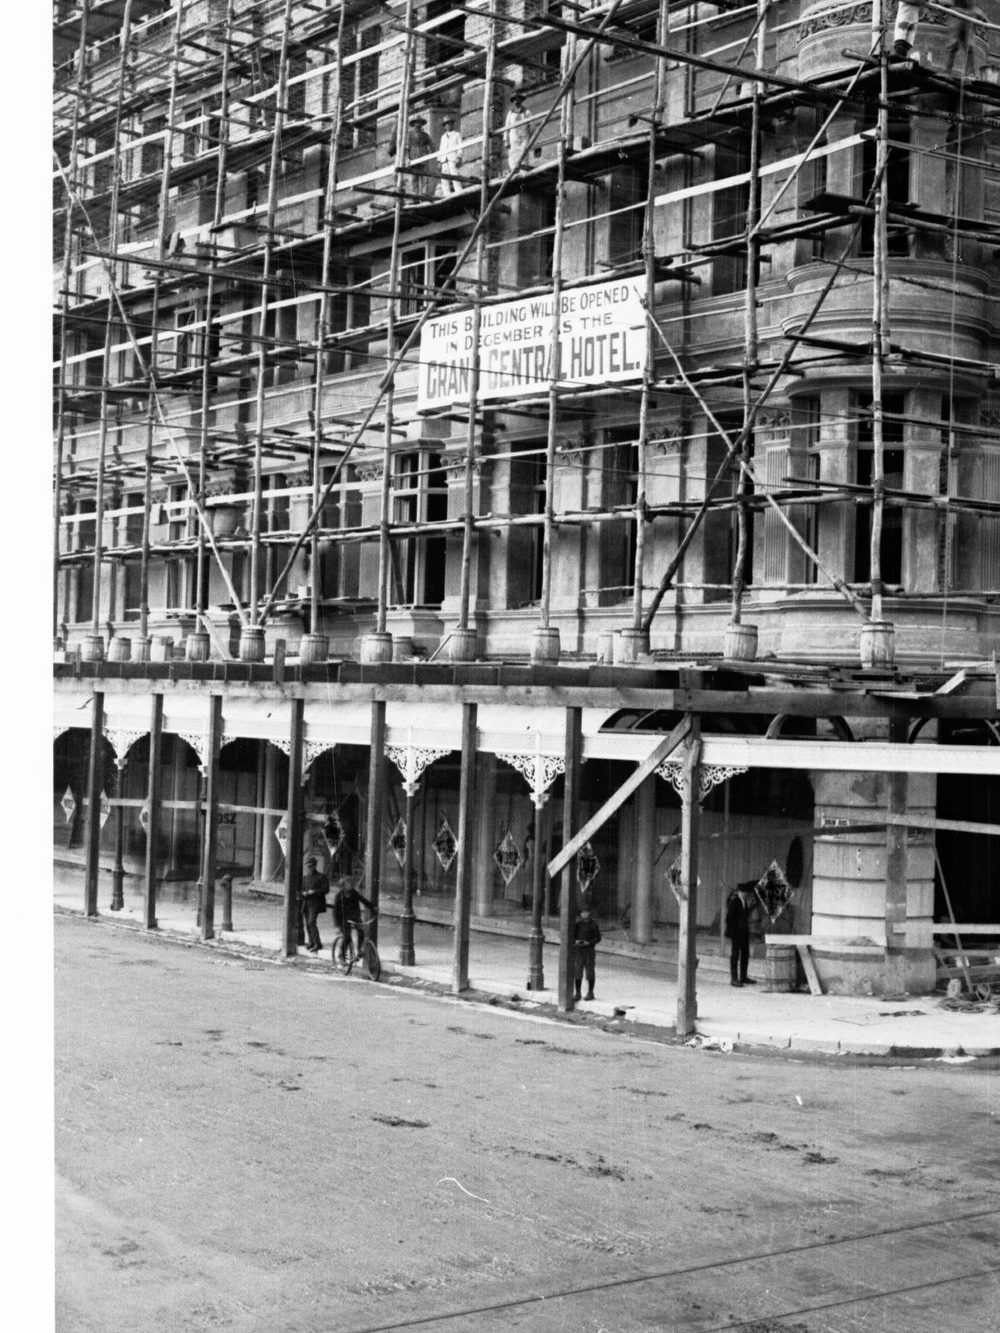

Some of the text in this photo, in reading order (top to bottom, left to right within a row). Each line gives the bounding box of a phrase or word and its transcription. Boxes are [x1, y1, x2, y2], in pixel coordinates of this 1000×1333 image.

[430, 320, 458, 339] THIS
[464, 307, 526, 332] BILDING
[561, 296, 576, 314] BE
[580, 285, 629, 310] OPENED
[446, 340, 458, 354] IN
[580, 312, 613, 330] THE
[426, 356, 480, 400] GRAN
[570, 331, 641, 379] HOTEL.
